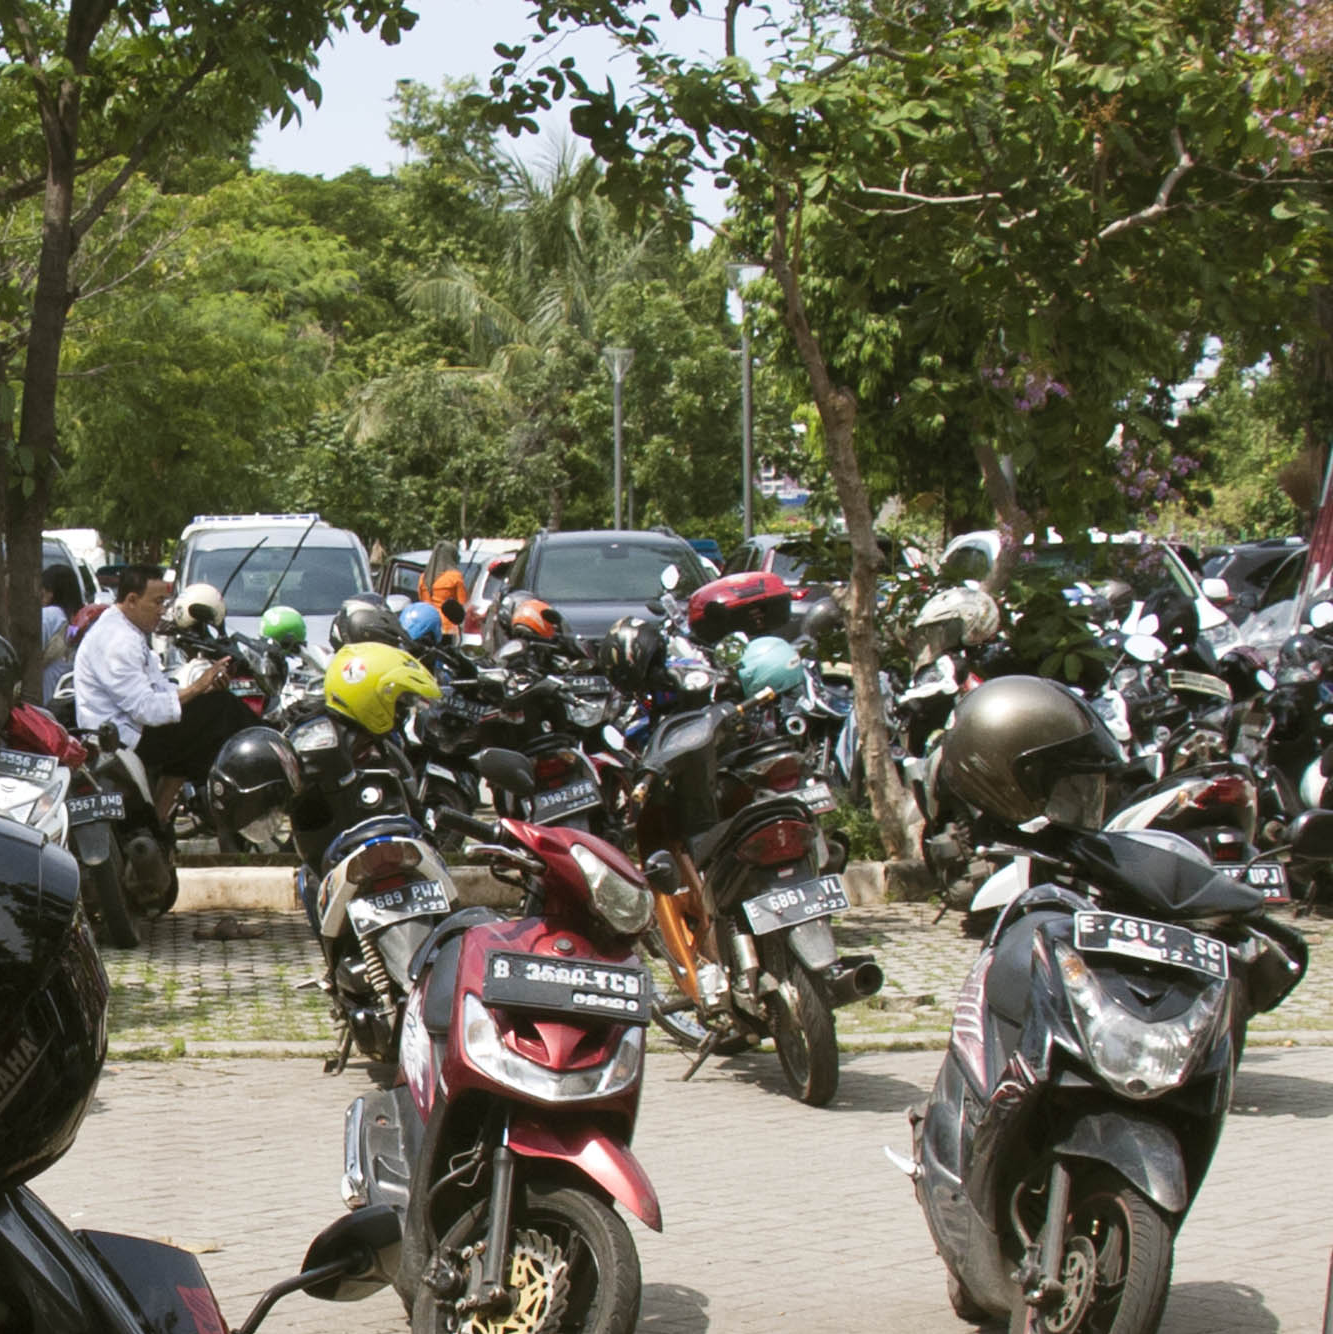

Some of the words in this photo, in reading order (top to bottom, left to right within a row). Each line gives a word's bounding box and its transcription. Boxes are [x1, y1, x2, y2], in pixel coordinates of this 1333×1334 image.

[747, 903, 760, 918] E
[768, 889, 807, 910] 6861
[819, 878, 842, 895] YL
[1109, 918, 1167, 944] 4614
[1193, 937, 1221, 960] SC
[494, 959, 510, 979] B
